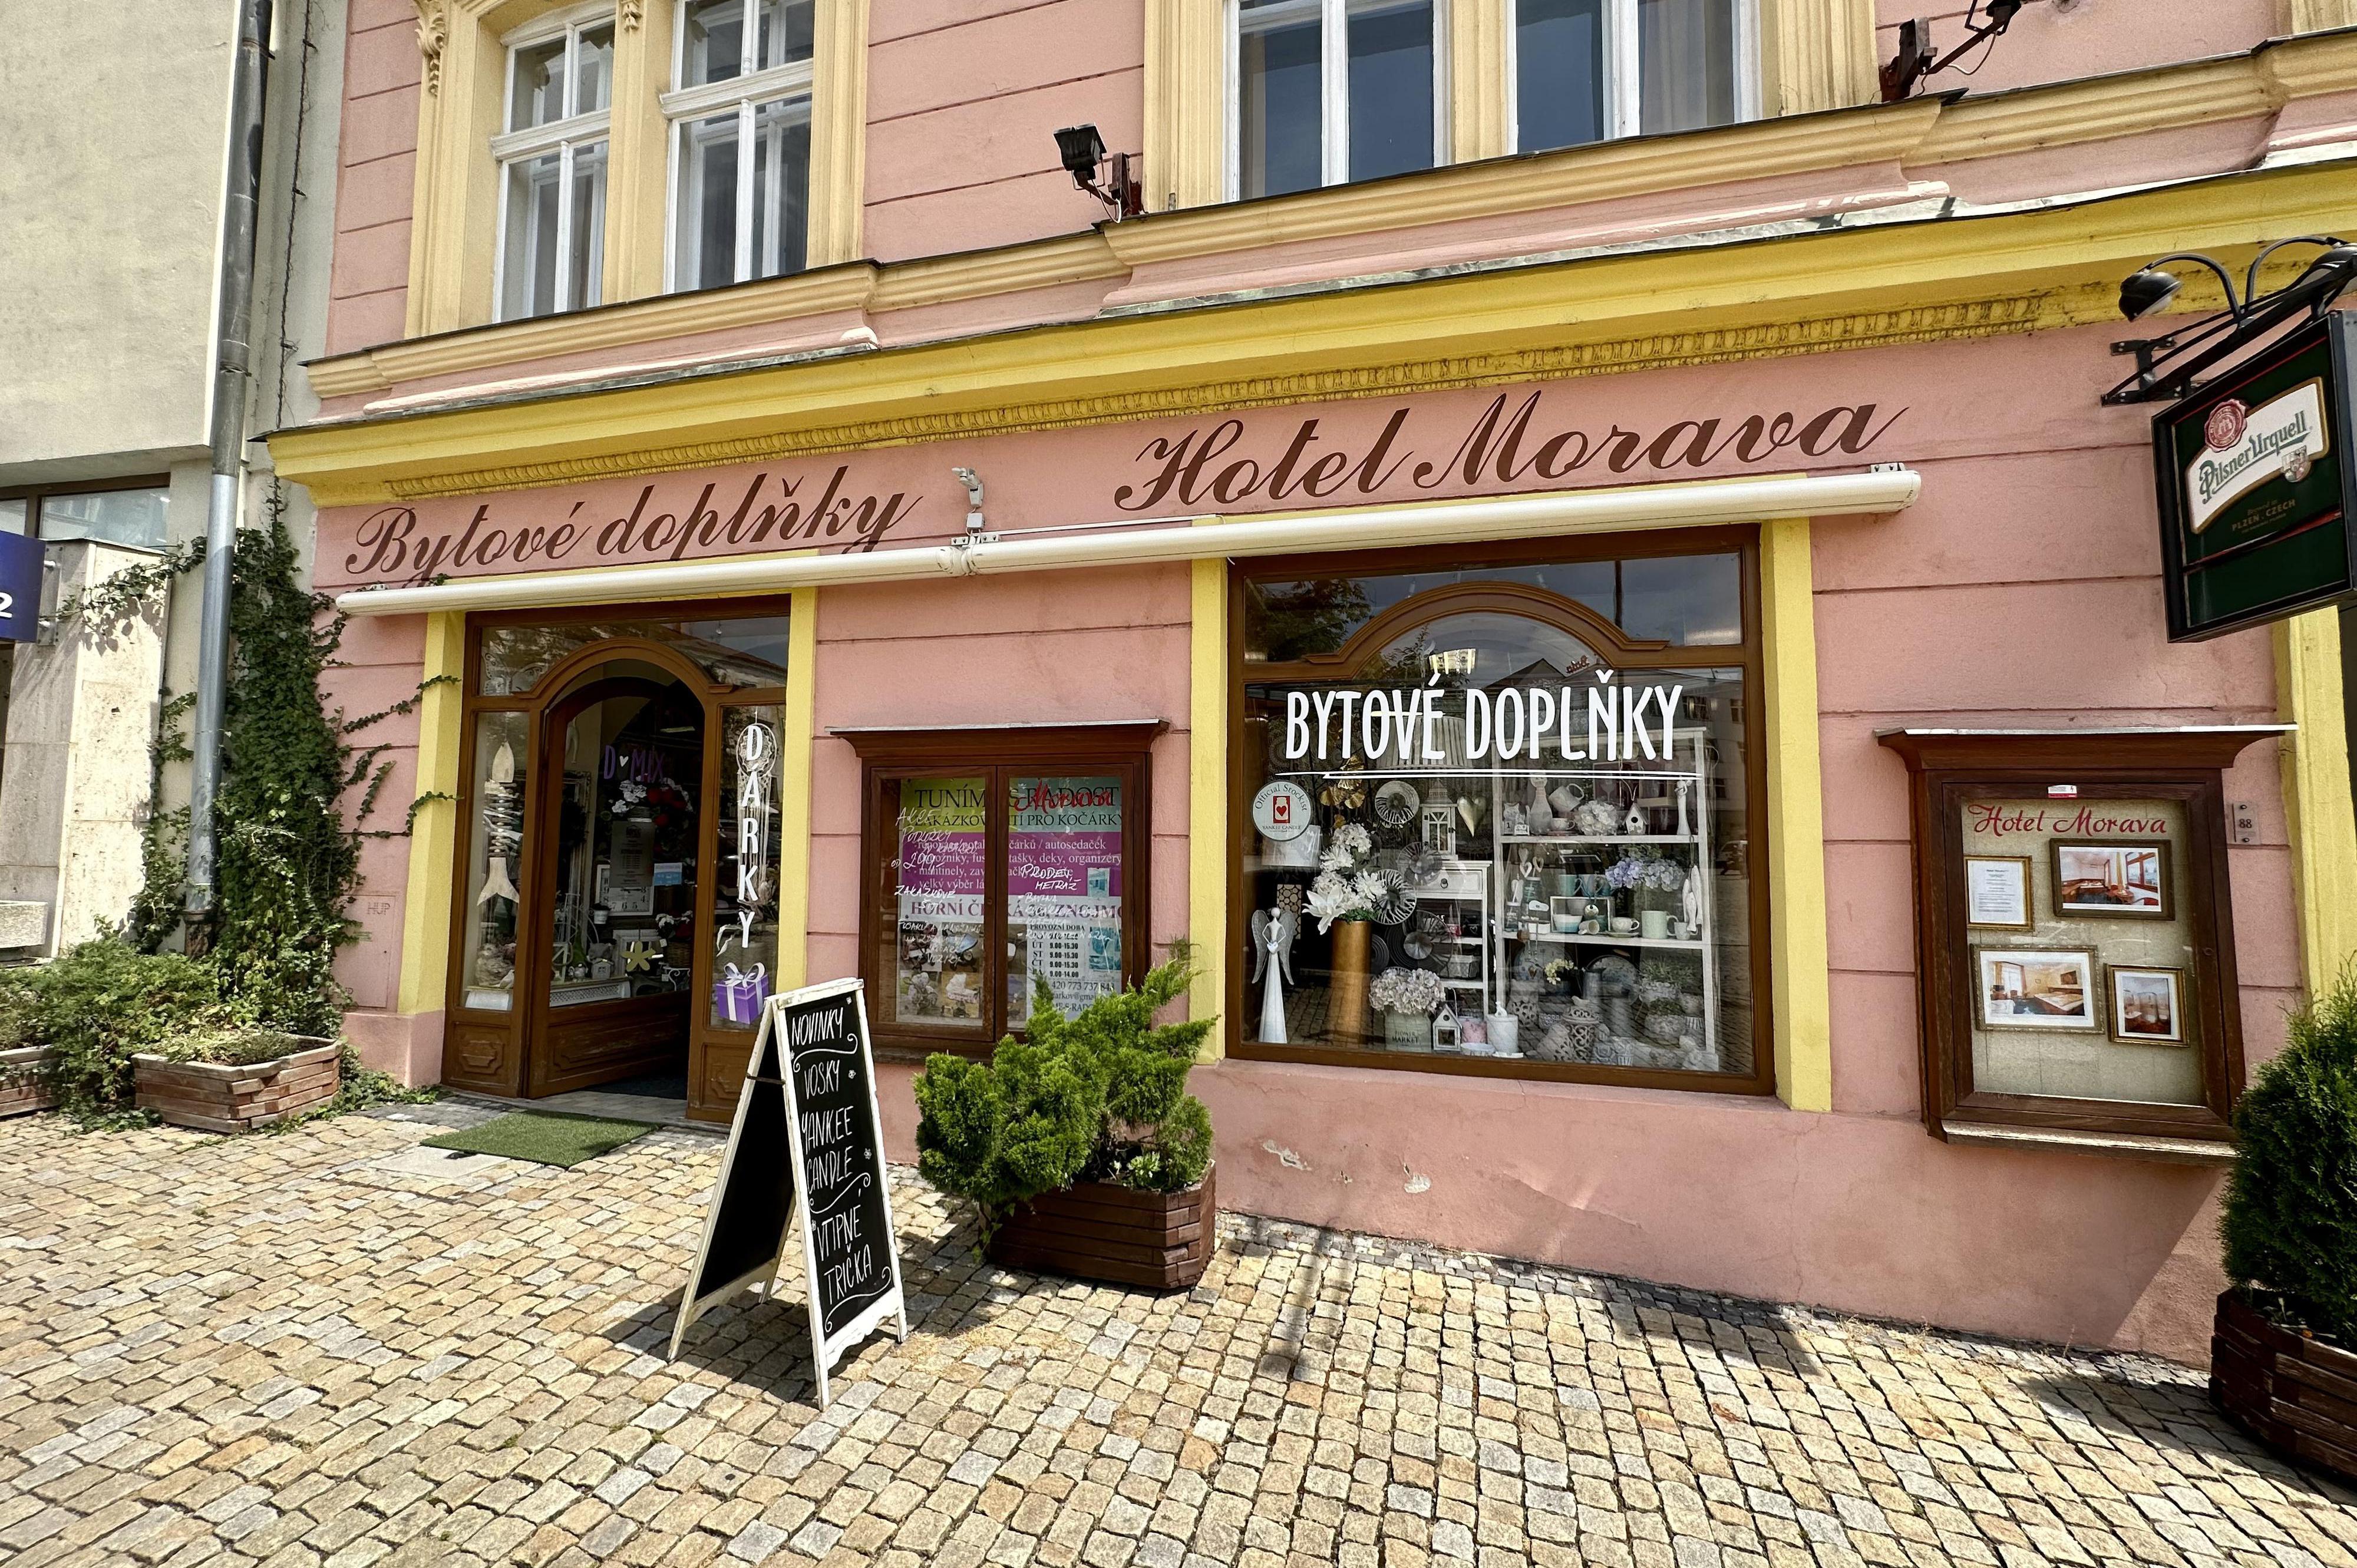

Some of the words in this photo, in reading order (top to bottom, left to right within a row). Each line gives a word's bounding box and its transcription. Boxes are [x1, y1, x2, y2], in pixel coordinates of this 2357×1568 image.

[1115, 407, 1414, 512] Hotel
[1414, 390, 1909, 489] Morava
[2198, 446, 2252, 504] Pilsner
[2249, 410, 2307, 459] Urquell
[346, 501, 592, 588] Bytové
[596, 465, 924, 554] doplňky
[1285, 673, 1446, 761] BYTOVÉ
[1465, 669, 1683, 761] DOPLŇKY
[915, 783, 986, 808] TUNÍM
[1025, 786, 1121, 807] RADOST
[1255, 783, 1280, 810] Official
[1283, 784, 1308, 811] Stockist
[738, 725, 763, 949] DÁRKY
[915, 812, 986, 826] ZAKÁZKOV
[1028, 814, 1055, 826] PRO
[1968, 804, 2045, 837] Hotel
[2052, 805, 2167, 837] Morava
[2239, 818, 2252, 828] 88
[1009, 839, 1036, 849] čárků
[1045, 839, 1107, 850] autosedaček
[976, 877, 985, 889] lá
[1067, 981, 1082, 991] 773
[1084, 981, 1098, 991] 737
[791, 1006, 844, 1047] NOVINKY
[804, 1059, 840, 1100] VOSKY
[801, 1105, 854, 1155] YANKEE
[806, 1145, 853, 1194] CANDLE
[817, 1188, 862, 1262] VTIPNÉ
[823, 1242, 873, 1305] TRIČKA
